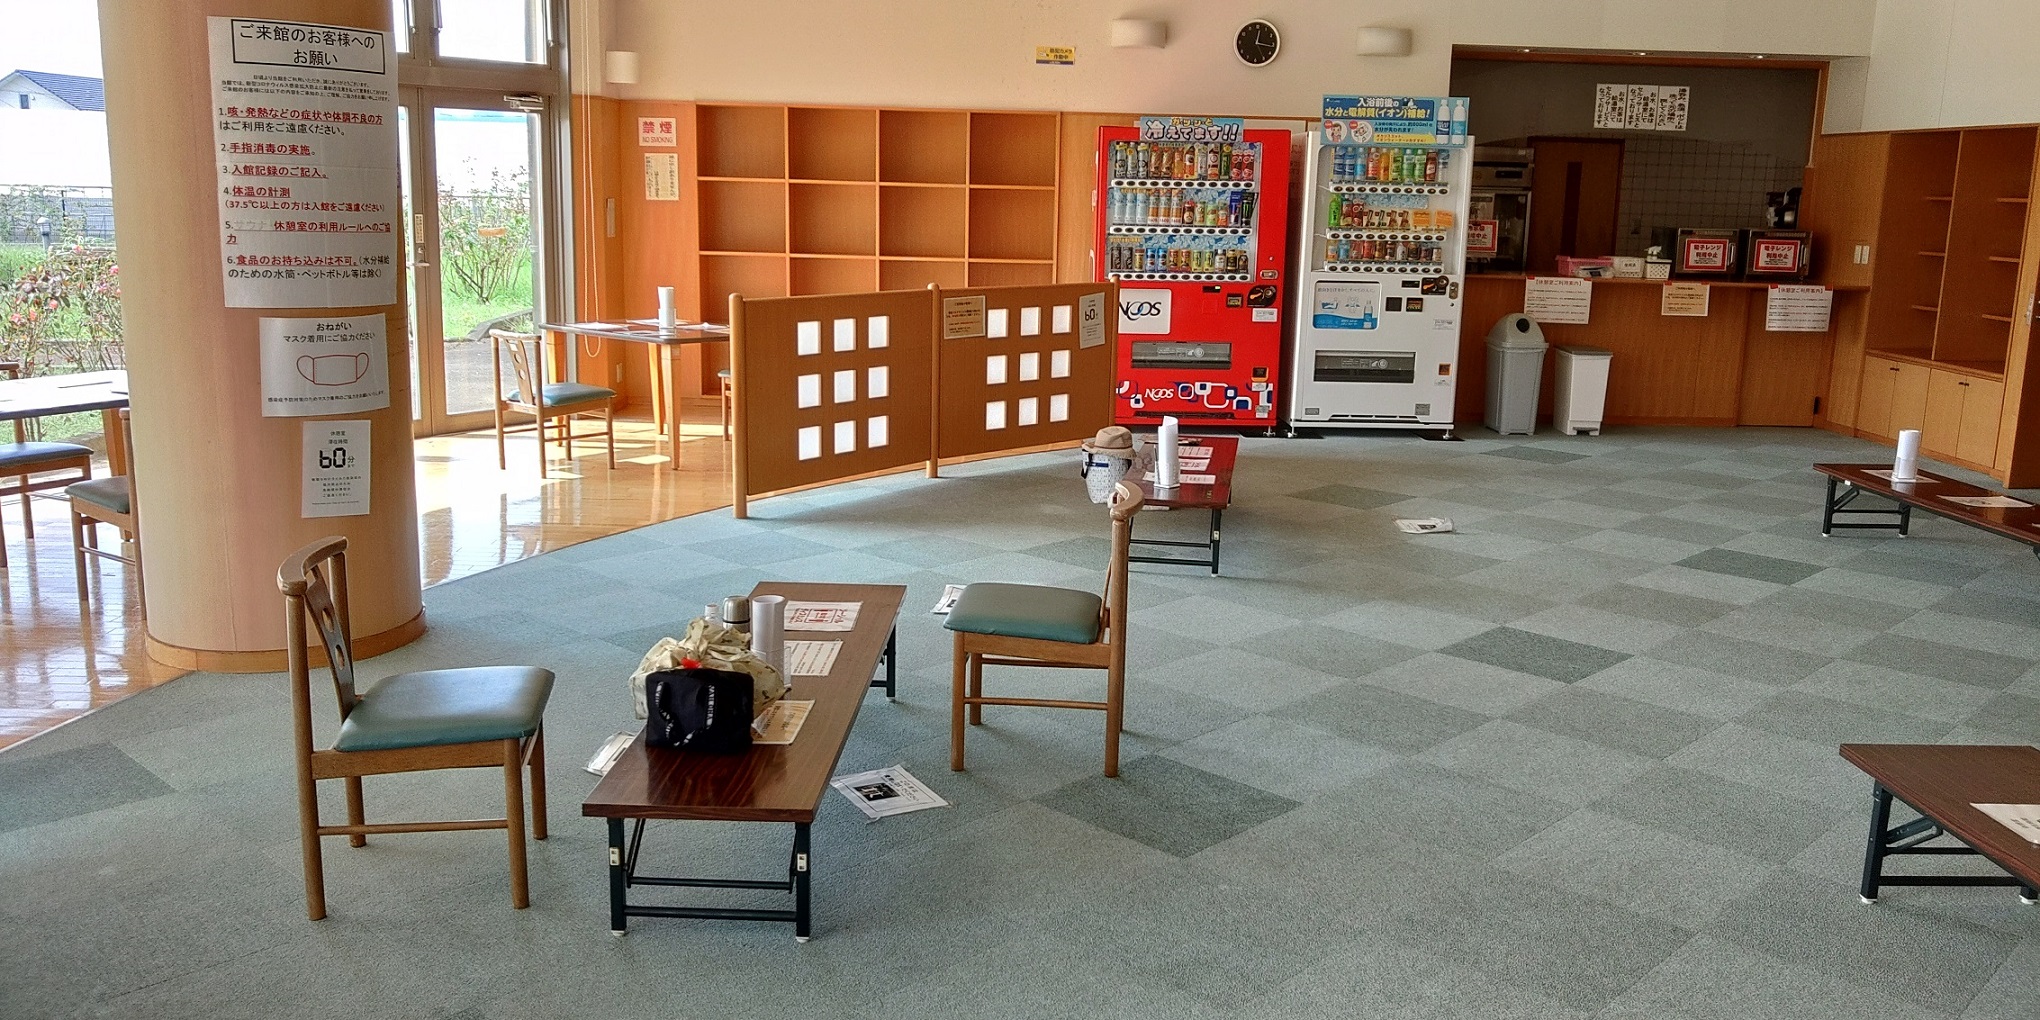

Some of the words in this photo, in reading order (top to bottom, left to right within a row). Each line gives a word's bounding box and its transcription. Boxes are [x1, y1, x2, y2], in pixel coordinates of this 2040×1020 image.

[240, 24, 375, 49] ご来館のお客様への
[293, 49, 338, 66] お願い
[1357, 97, 1399, 107] 入浴前後の
[219, 121, 345, 136] はご利用をご遠慮ください。
[642, 121, 672, 134] 禁煙
[226, 234, 237, 244] 力
[316, 322, 352, 332] おねがい
[283, 332, 375, 343] マスク着用にご協力ください
[319, 447, 346, 469] 60
